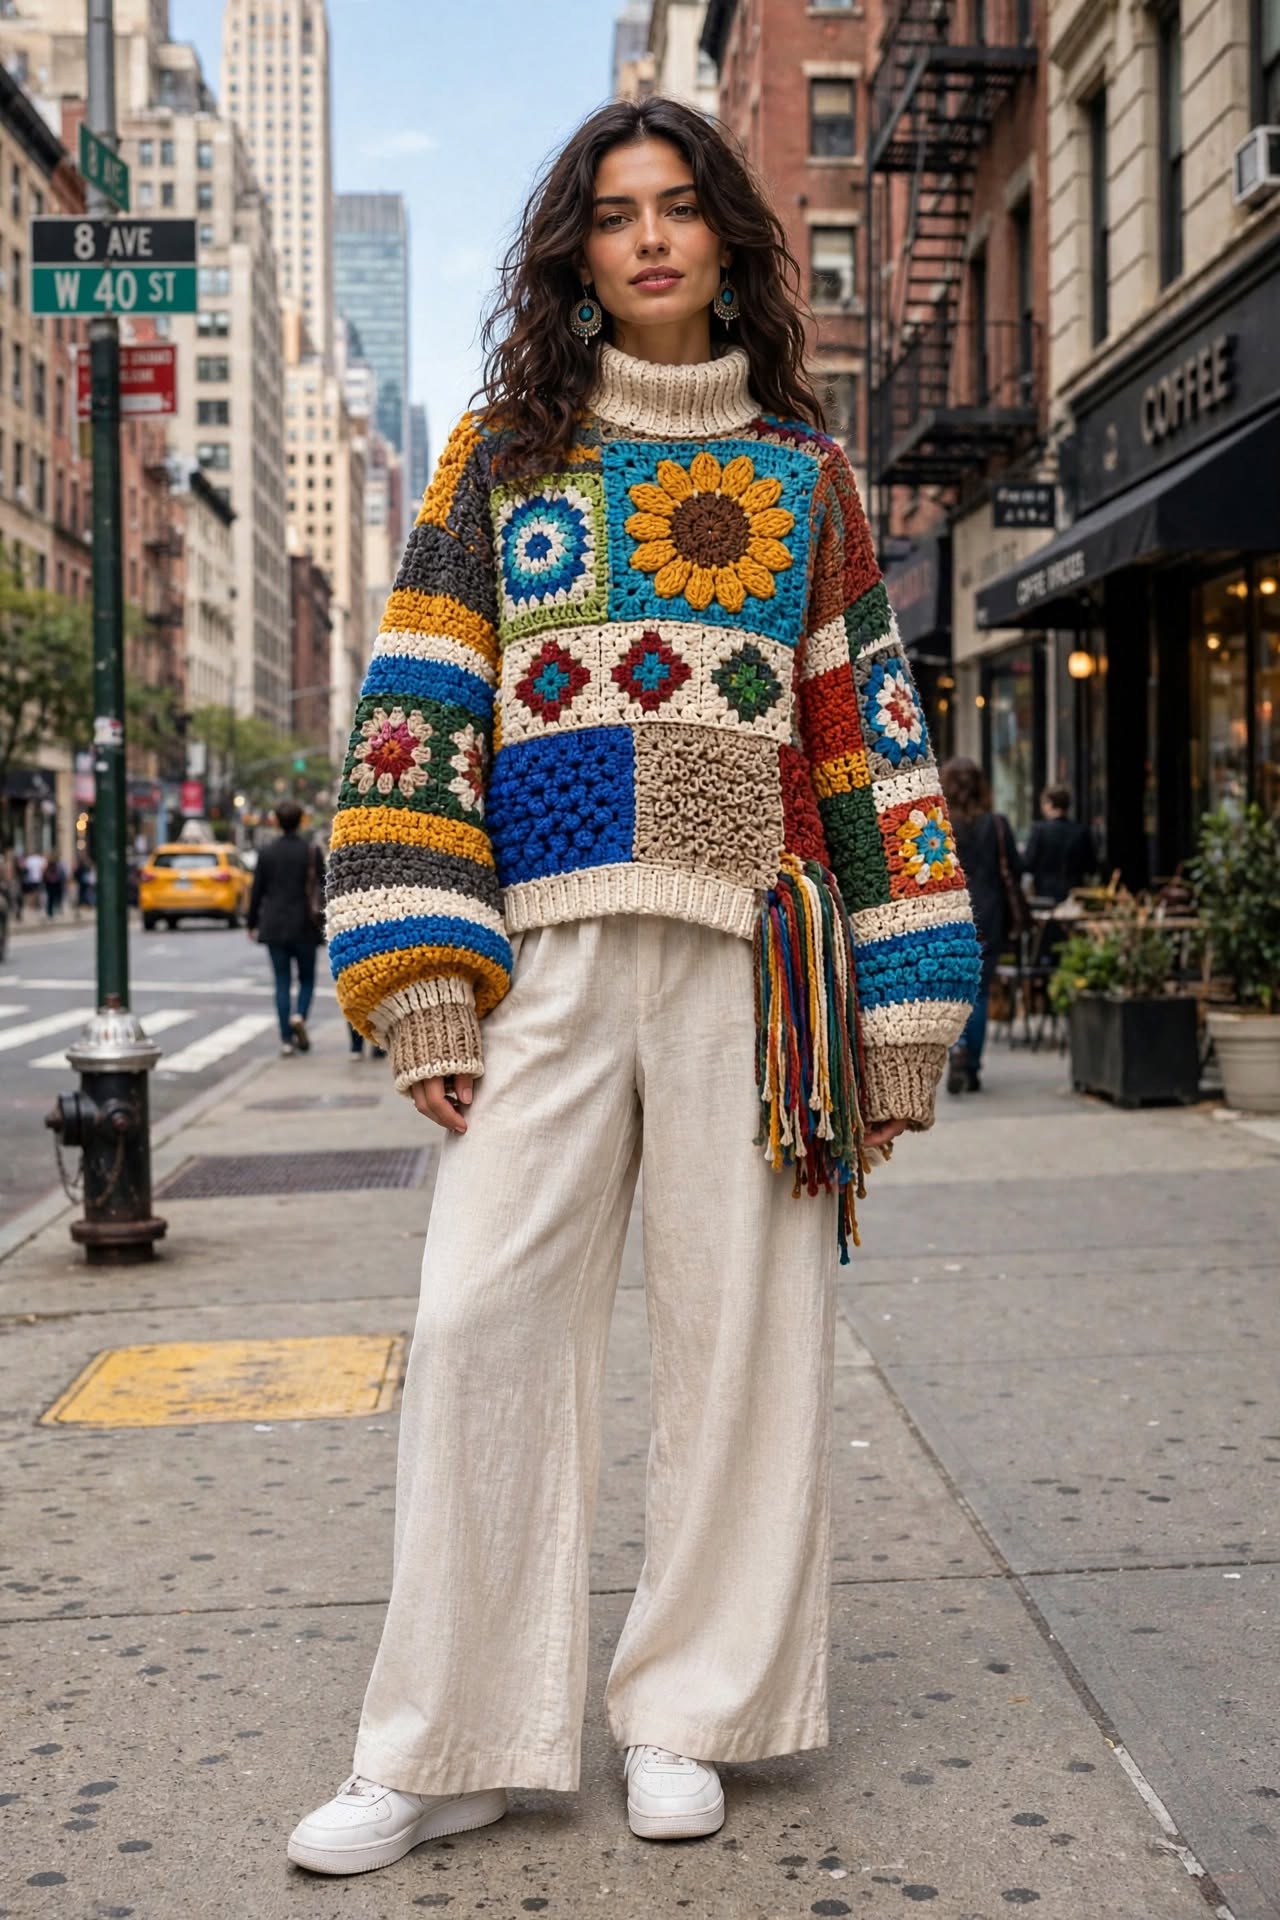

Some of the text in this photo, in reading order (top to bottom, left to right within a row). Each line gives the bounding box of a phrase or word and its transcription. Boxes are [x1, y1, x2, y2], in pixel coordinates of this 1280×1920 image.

[74, 223, 153, 260] 8 AVE
[54, 269, 176, 310] W 40 ST
[1141, 335, 1227, 445] COFFEE
